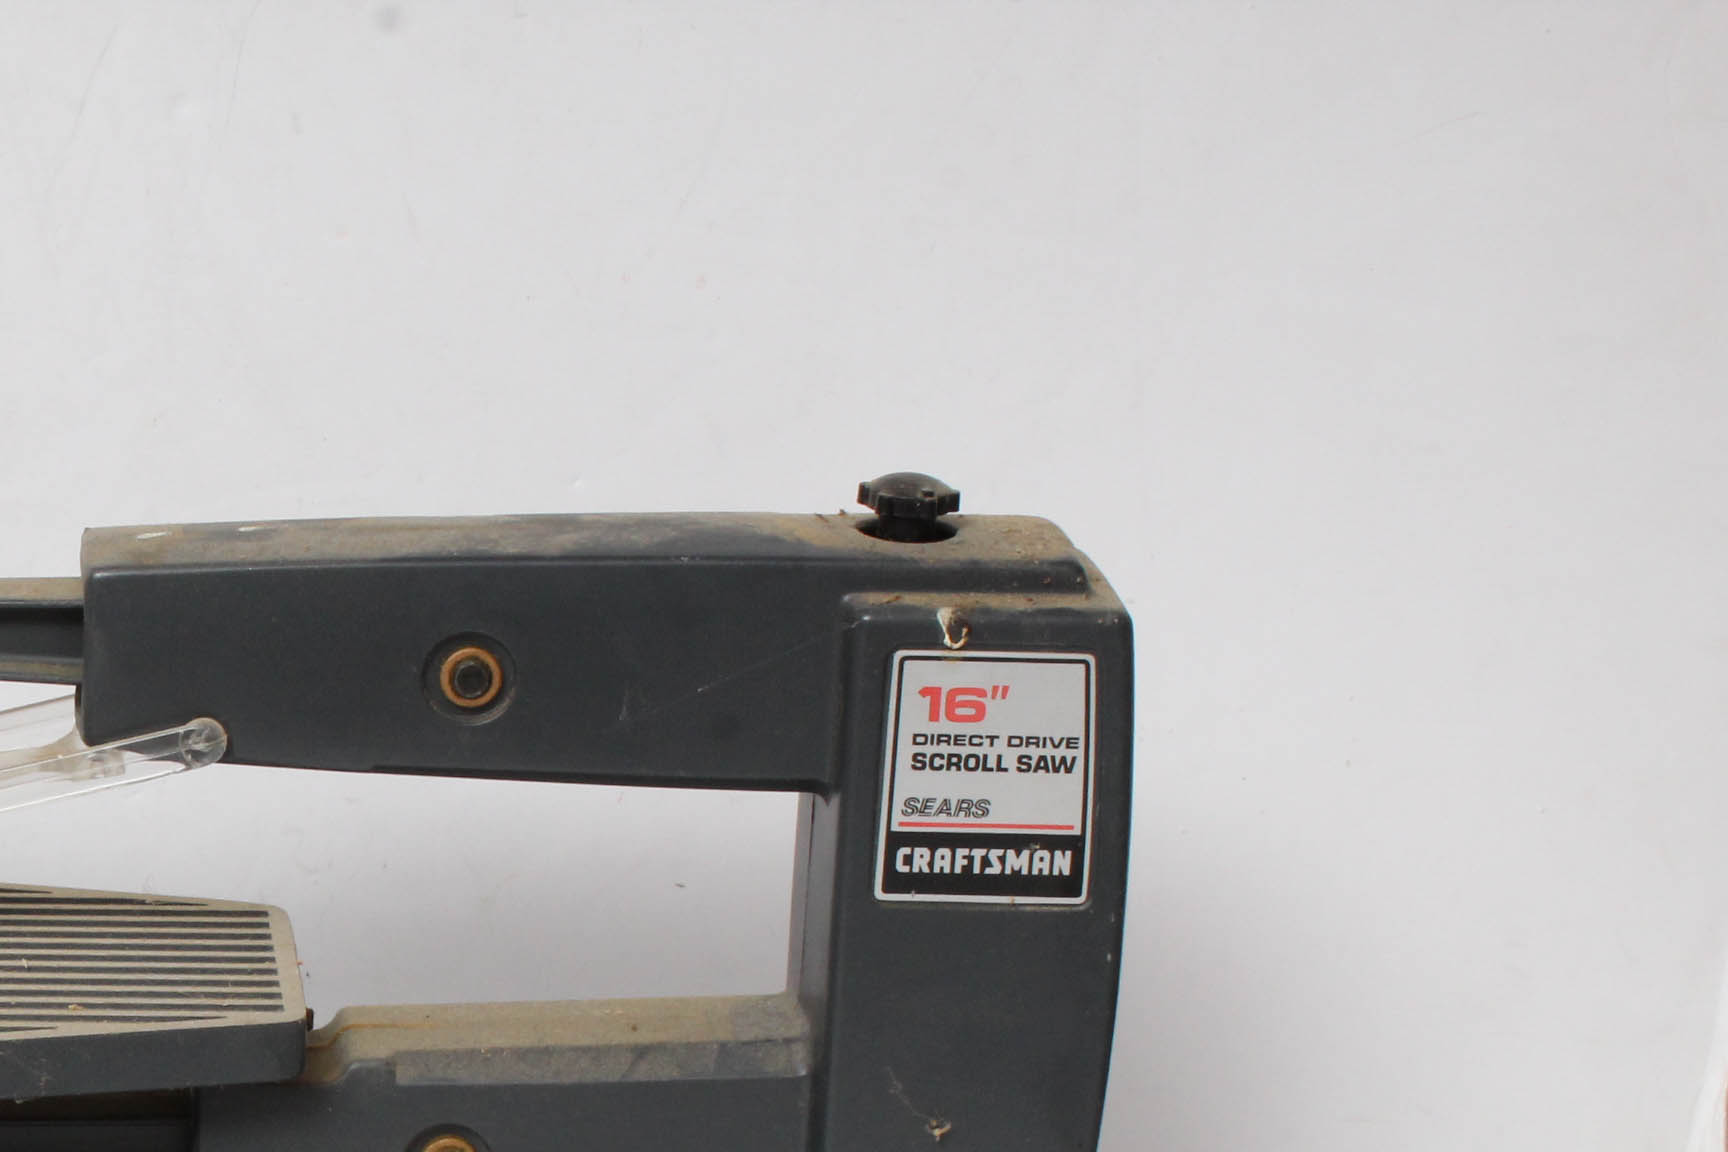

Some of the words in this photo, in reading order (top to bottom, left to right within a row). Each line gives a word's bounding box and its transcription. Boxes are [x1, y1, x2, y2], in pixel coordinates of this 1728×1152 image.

[918, 685, 1010, 723] 16"
[912, 733, 1000, 748] DIRECT
[1007, 735, 1080, 749] DRIVE
[911, 752, 1009, 773] SCROLL
[1016, 754, 1077, 774] SAW
[901, 797, 991, 818] SEARS
[895, 847, 1072, 876] CRAFTSMAN
